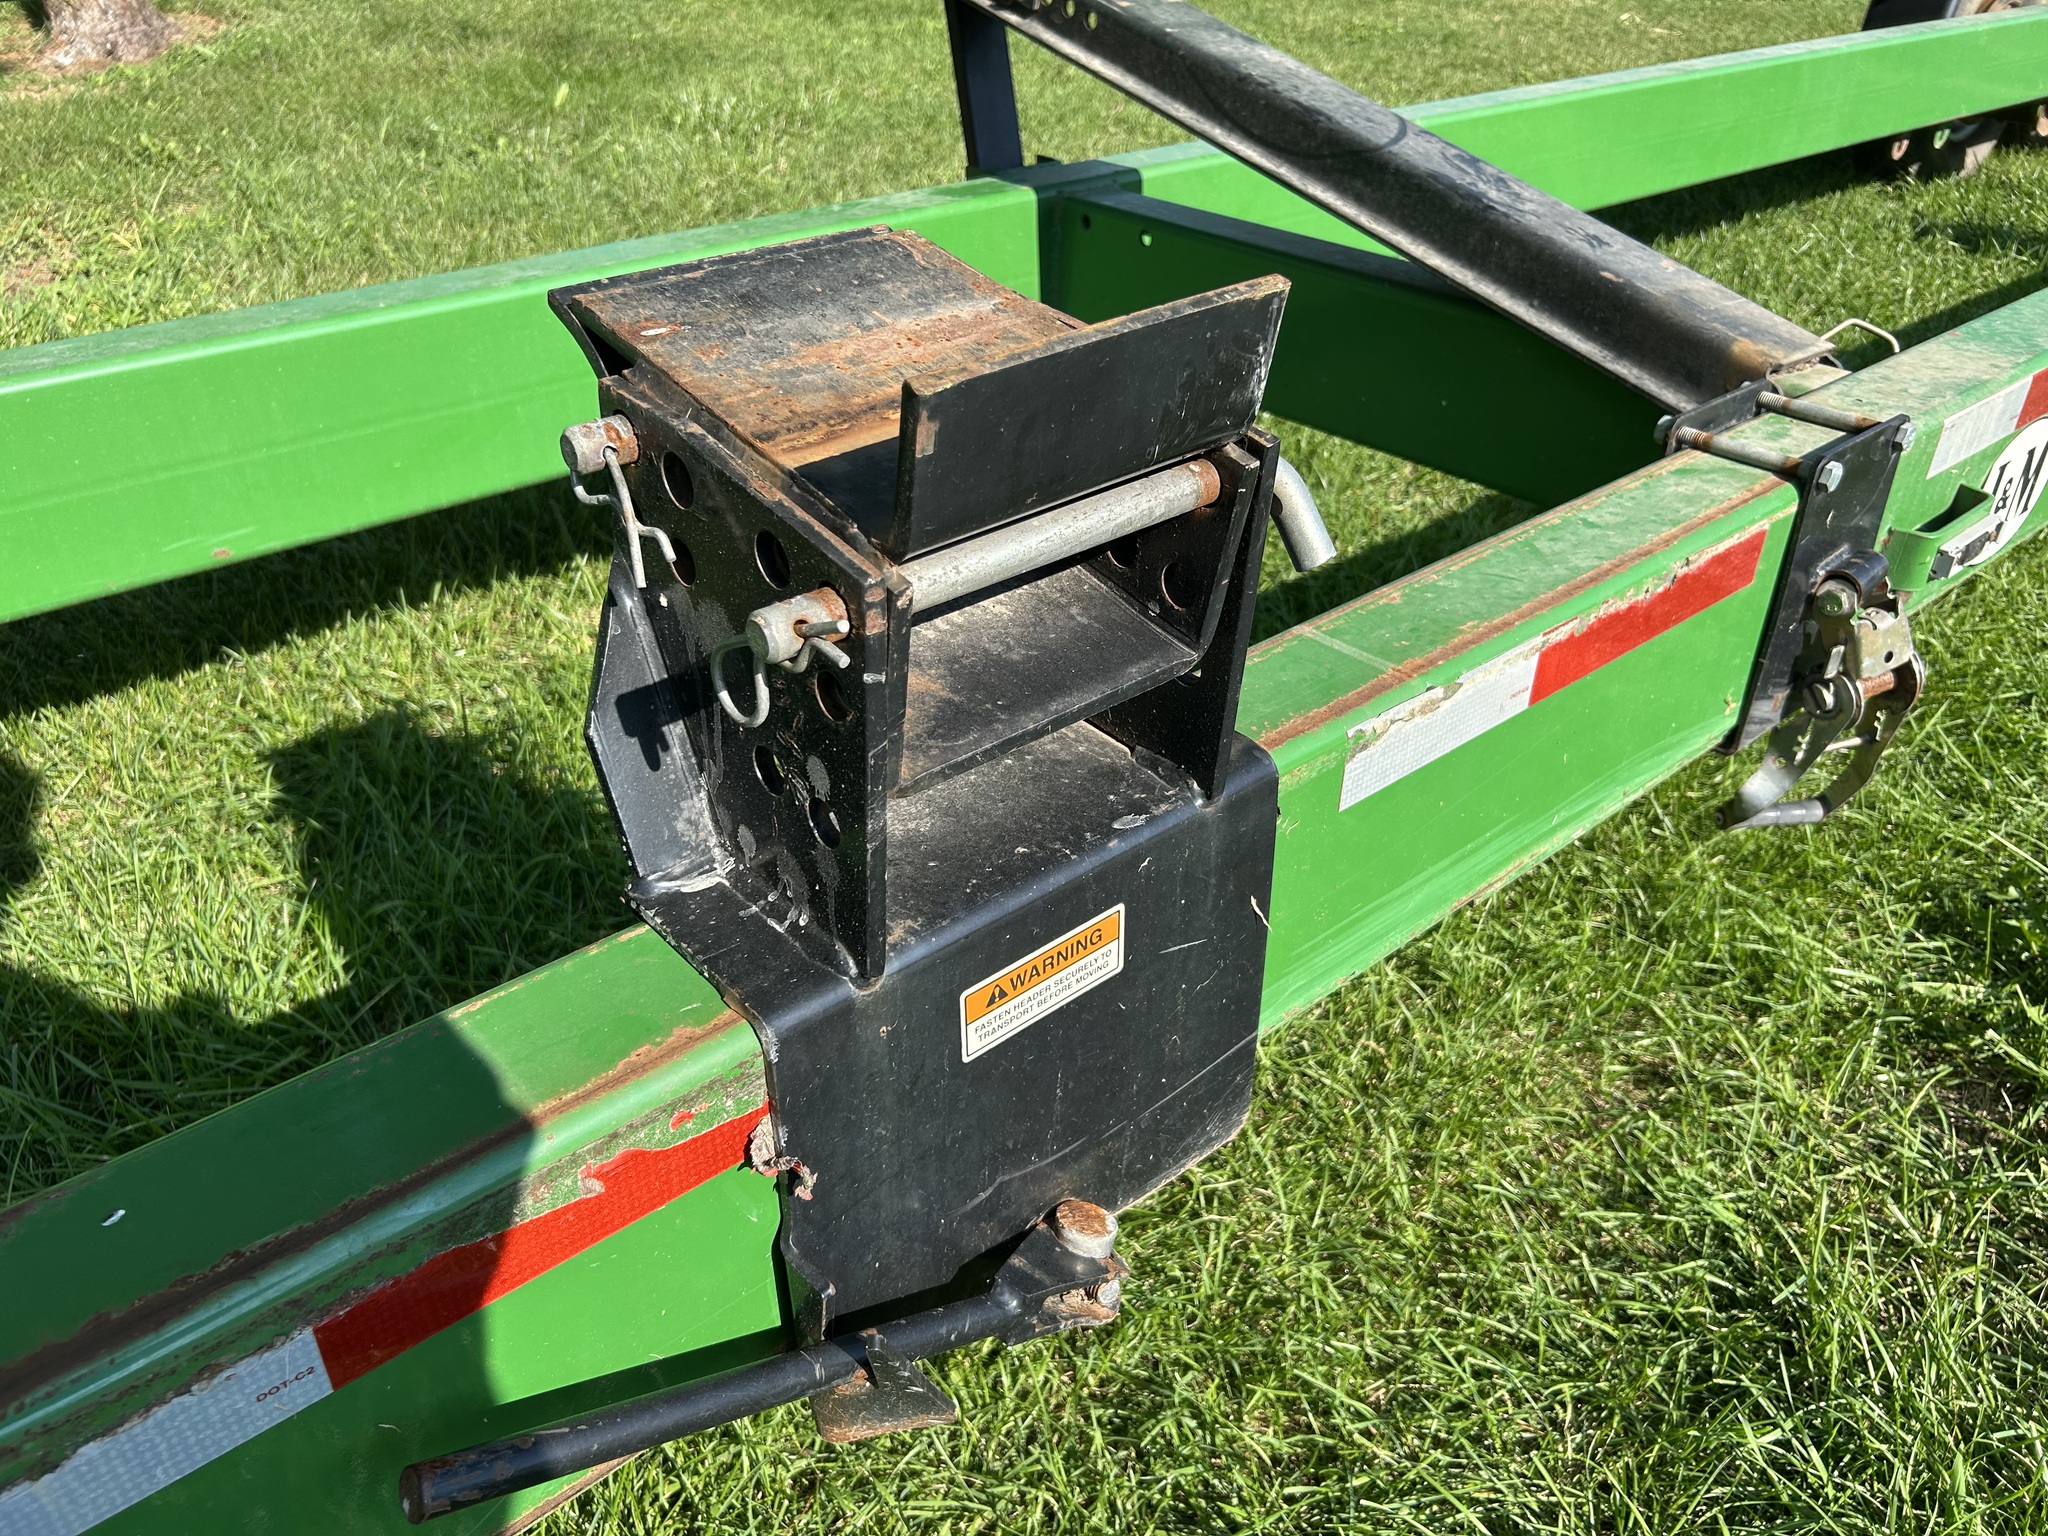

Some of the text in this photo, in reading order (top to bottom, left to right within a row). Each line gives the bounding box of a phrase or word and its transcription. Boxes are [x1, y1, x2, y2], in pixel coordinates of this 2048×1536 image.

[974, 948, 1112, 1035] FASTEN HEADER SECURELY TO
[1010, 928, 1103, 992] WARNING
[977, 961, 1110, 1042] TRANSPORT BEFORE MOVING
[256, 1366, 316, 1403] DOT-C2
